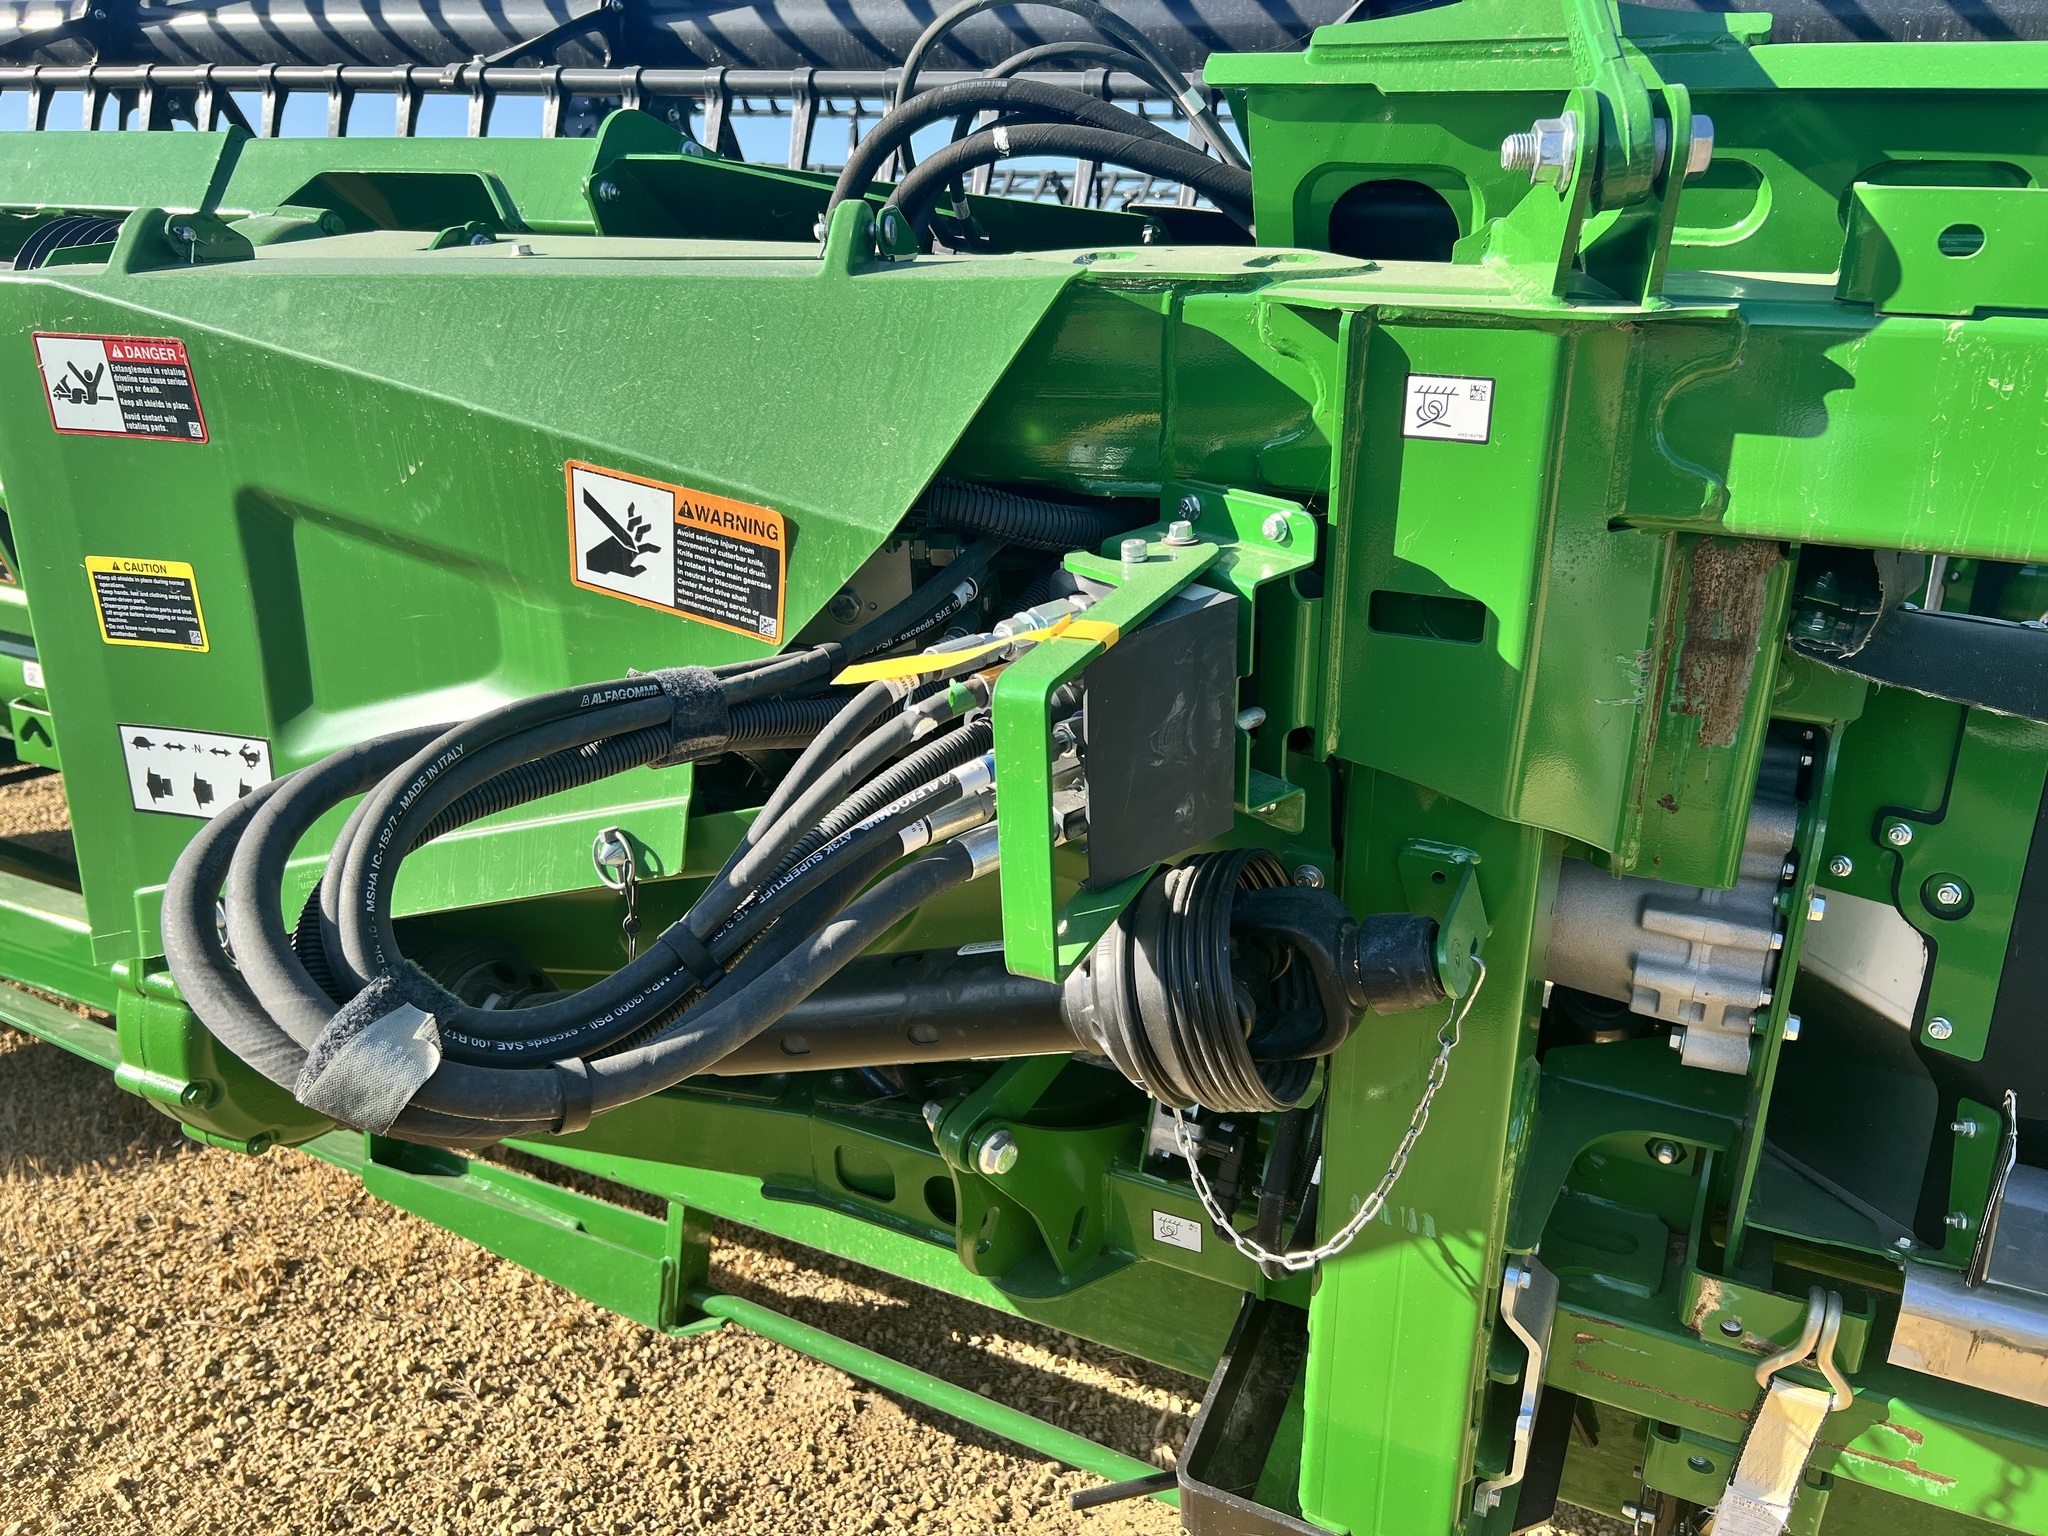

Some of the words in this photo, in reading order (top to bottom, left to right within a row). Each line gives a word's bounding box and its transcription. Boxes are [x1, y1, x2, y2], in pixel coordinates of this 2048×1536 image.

[124, 346, 177, 361] DANGER
[111, 364, 152, 374] Entanglement
[161, 368, 186, 377] rotating
[114, 374, 138, 382] driveline
[116, 384, 133, 393] injury
[120, 398, 134, 407] Keep
[145, 400, 165, 408] shields
[173, 402, 191, 410] place.
[127, 423, 150, 431] rotating
[151, 424, 168, 432] parts.
[142, 413, 162, 422] contact
[695, 504, 778, 541] WARNING
[677, 529, 694, 538] Avoid
[696, 534, 719, 545] serious
[720, 540, 738, 551] injury
[740, 545, 754, 555] from
[677, 540, 709, 552] movement
[718, 550, 746, 562] cutterbar
[748, 556, 765, 568] knife.
[677, 549, 693, 559] Knife
[694, 555, 714, 564] moves
[716, 559, 732, 569] when
[734, 564, 748, 573] feed
[749, 568, 766, 578] drum
[124, 562, 167, 574] CAUTION
[684, 560, 707, 572] rotated.
[708, 567, 725, 576] Place
[727, 572, 742, 581] main
[743, 577, 772, 589] gearcase
[677, 578, 697, 589] Center
[699, 583, 713, 593] Feed
[715, 588, 730, 598] drive
[732, 593, 747, 603] shaft
[685, 571, 706, 581] neutral
[715, 578, 750, 594] Disconnect
[104, 602, 128, 611] Disengage
[150, 592, 168, 600] clothing
[677, 588, 694, 597] when
[695, 593, 728, 608] performing
[729, 603, 751, 614] service
[177, 615, 197, 624] servicing
[678, 597, 715, 613] maintenance
[726, 611, 739, 620] feed
[740, 616, 758, 626] drum.
[900, 618, 935, 641] exceeds
[935, 605, 951, 621] SAE
[590, 684, 661, 706] ALFAGOMMA
[860, 778, 941, 831] ALFAGOMMA
[366, 873, 378, 912] MSHA
[372, 816, 398, 870] IC-152/7
[400, 776, 428, 810] MADE
[426, 764, 439, 780] IN
[438, 744, 465, 769] ITALY
[823, 834, 852, 855] AT3K
[759, 852, 823, 904] SUPERTUFF
[444, 1029, 468, 1044] R17
[497, 1041, 525, 1051] SAE
[526, 1029, 578, 1048] exceeds
